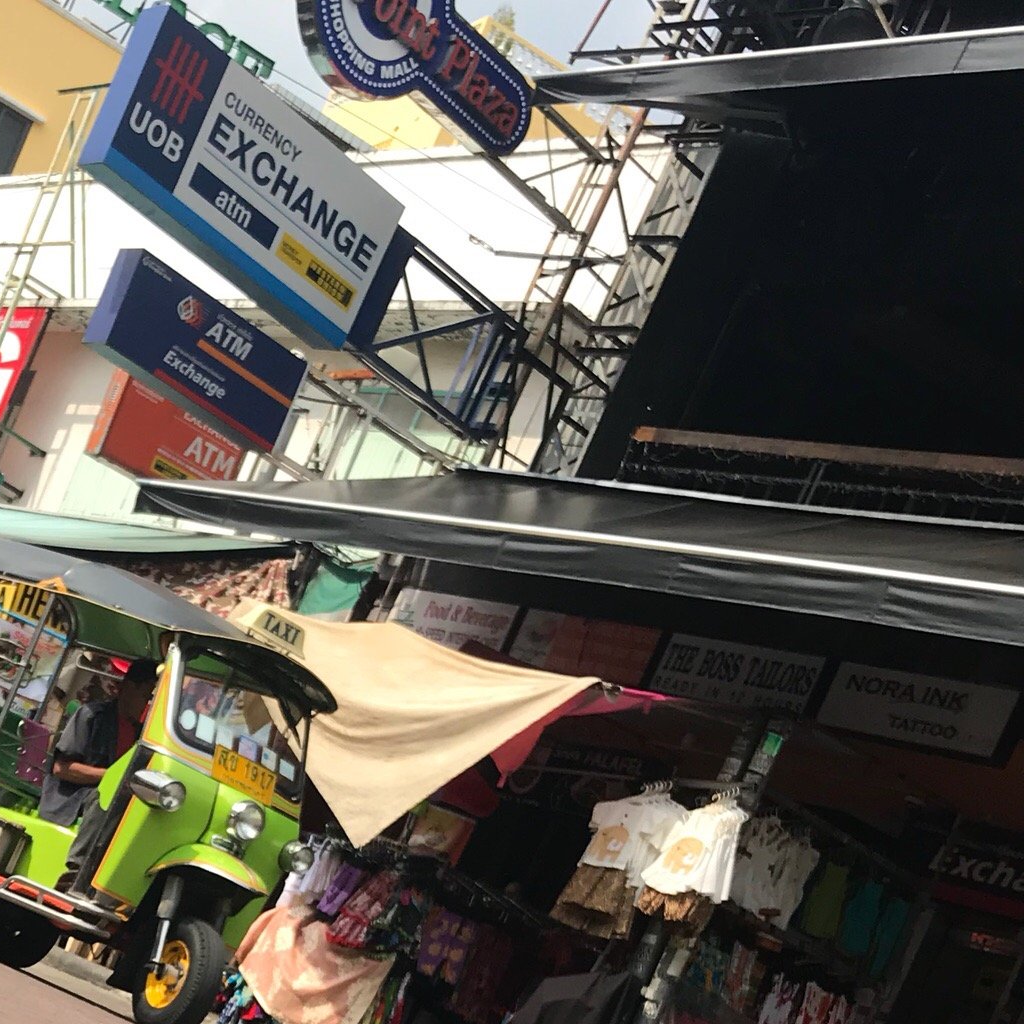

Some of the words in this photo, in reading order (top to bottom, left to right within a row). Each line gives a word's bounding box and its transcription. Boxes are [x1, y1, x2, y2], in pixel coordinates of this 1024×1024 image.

[329, 0, 375, 75] HOPPING
[380, 57, 419, 79] MALL
[437, 36, 519, 137] Plaza
[129, 102, 186, 163] UOB
[224, 92, 303, 163] CURRENCY
[207, 112, 378, 273] EXCHANGE
[214, 187, 253, 229] atm
[205, 322, 253, 361] ATM
[163, 349, 226, 400] Exchange
[183, 436, 235, 480] ATM
[264, 611, 301, 645] TAXI
[663, 643, 700, 673] THE
[698, 649, 744, 683] BOSS
[846, 674, 915, 702] NORA
[925, 686, 968, 712] INK
[889, 713, 957, 740] TATTOO
[929, 846, 1024, 891] Excha
